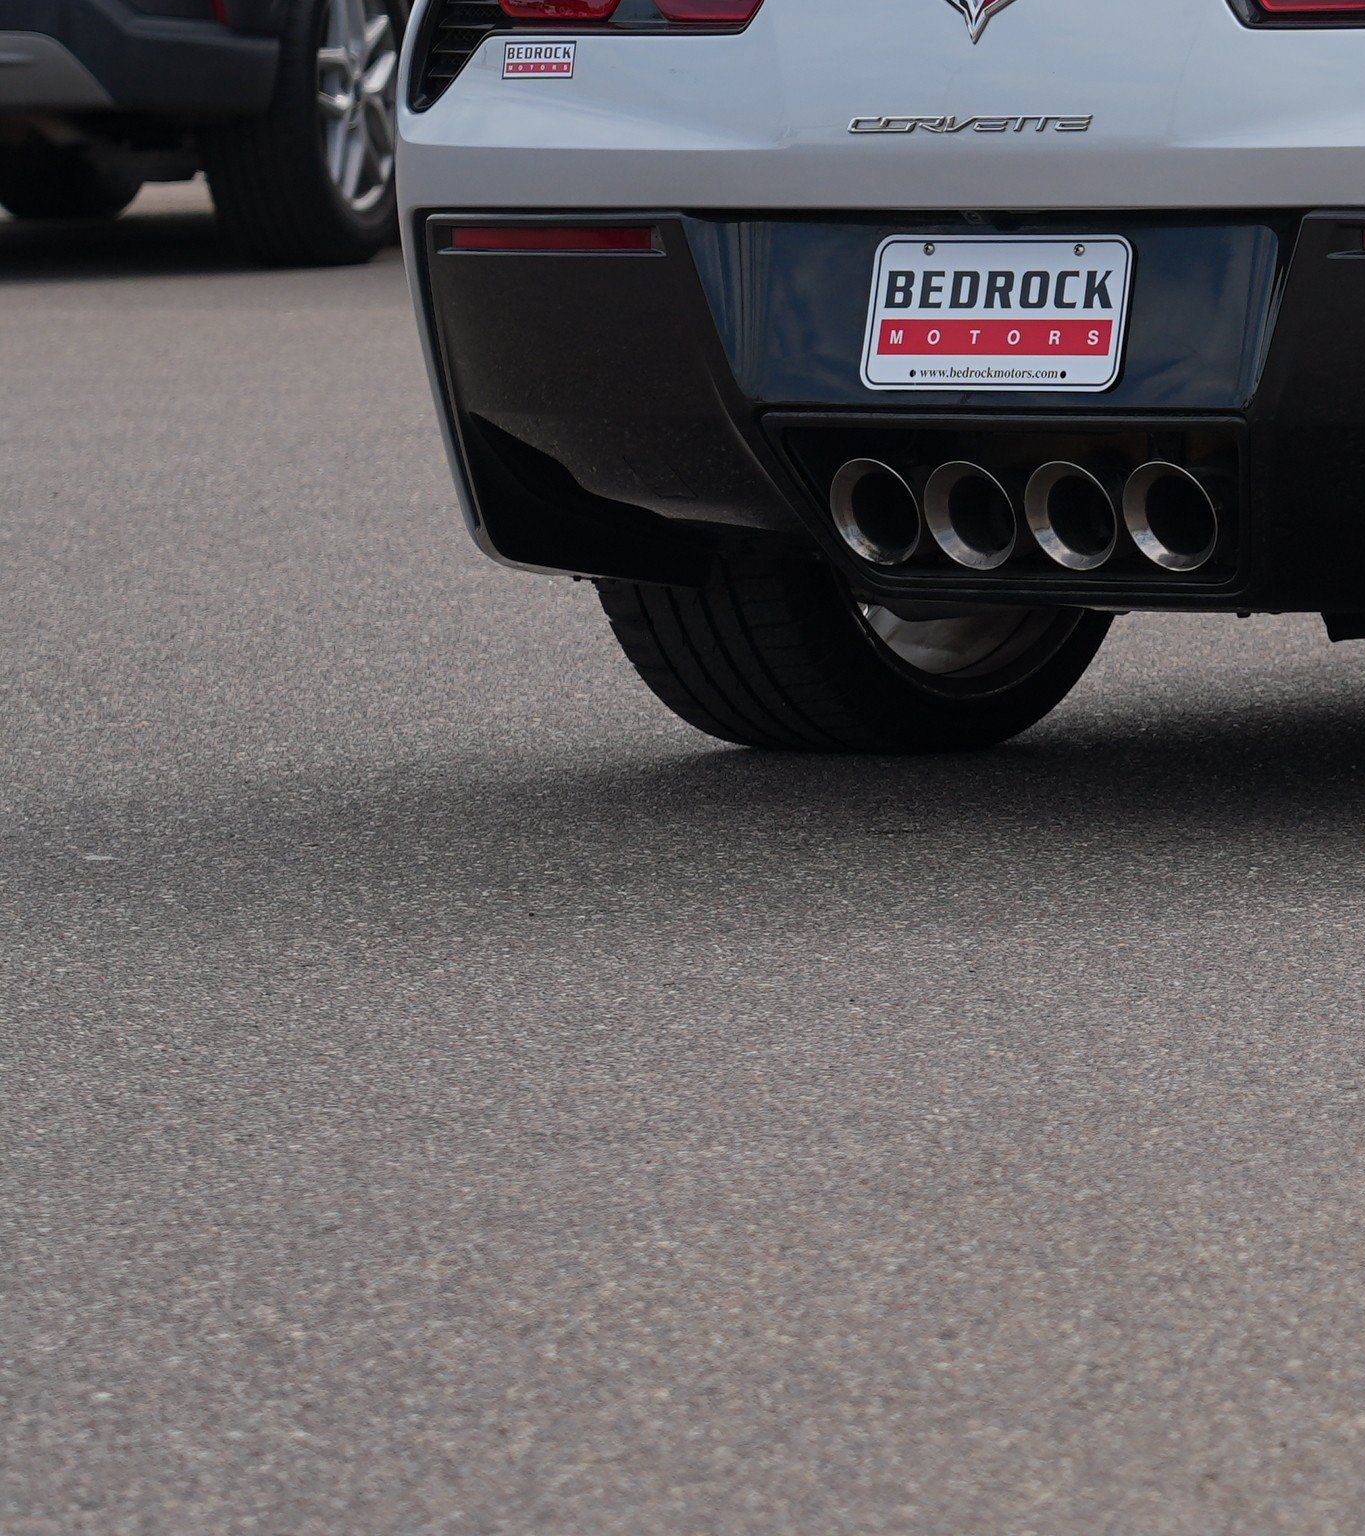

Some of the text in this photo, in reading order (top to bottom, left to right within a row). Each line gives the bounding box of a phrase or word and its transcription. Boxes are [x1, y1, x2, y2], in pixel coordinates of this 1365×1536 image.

[507, 46, 571, 60] BEDROCK
[507, 64, 569, 72] MOTORS
[847, 113, 1094, 133] CORVETTE
[883, 270, 1114, 309] BEDROCK
[889, 329, 1100, 345] MOTORS
[919, 367, 1059, 379] www.bedrockmotors.com
